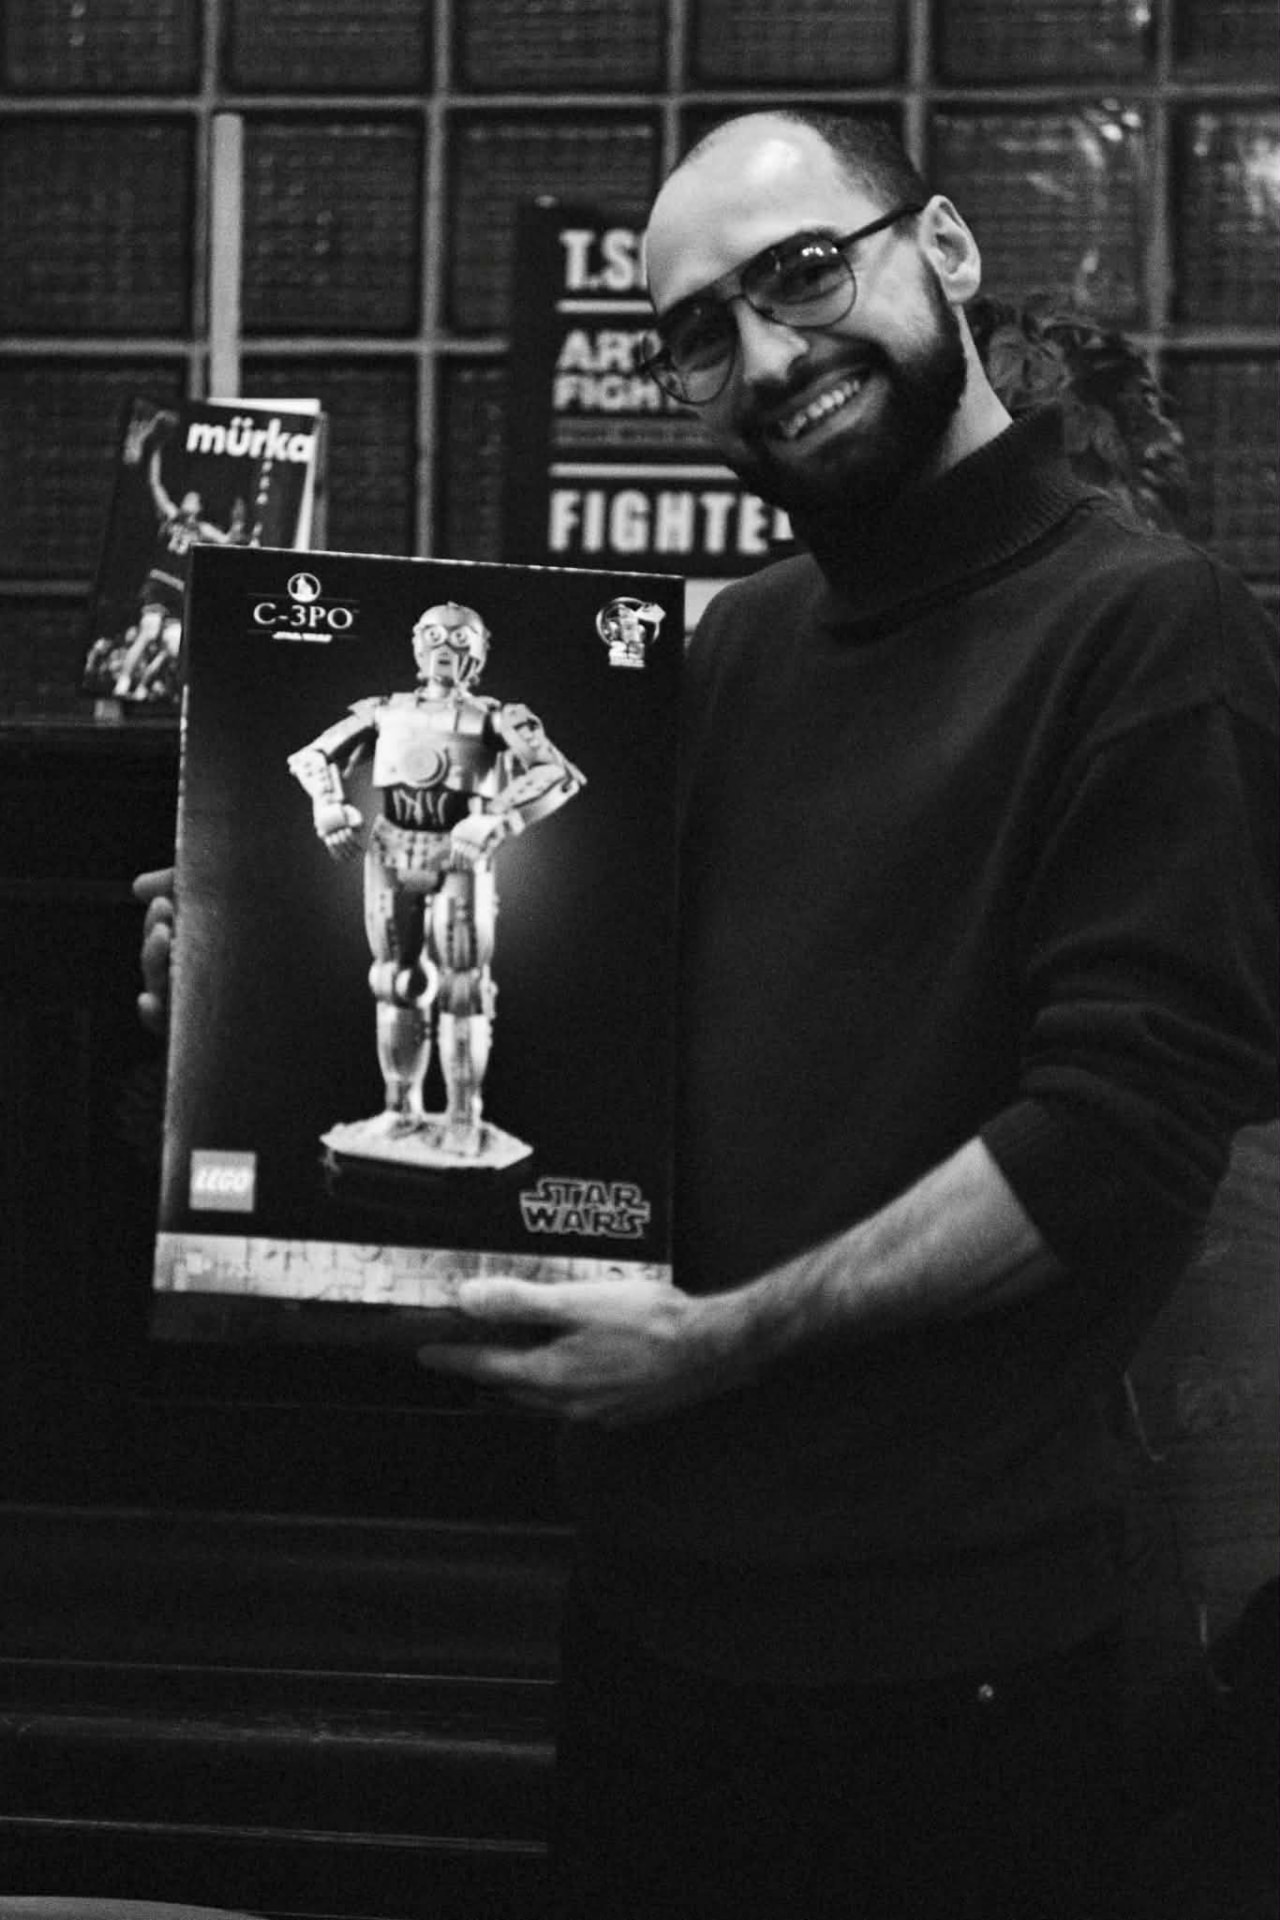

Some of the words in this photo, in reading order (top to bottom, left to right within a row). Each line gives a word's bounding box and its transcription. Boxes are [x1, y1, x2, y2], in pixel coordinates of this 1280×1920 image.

[558, 228, 647, 291] T.S
[552, 374, 680, 411] FIGH
[186, 416, 316, 463] mürka
[253, 602, 353, 629] C-3PO
[194, 1166, 252, 1193] LEGO
[519, 1176, 650, 1210] STAR
[520, 1203, 650, 1239] WARS
